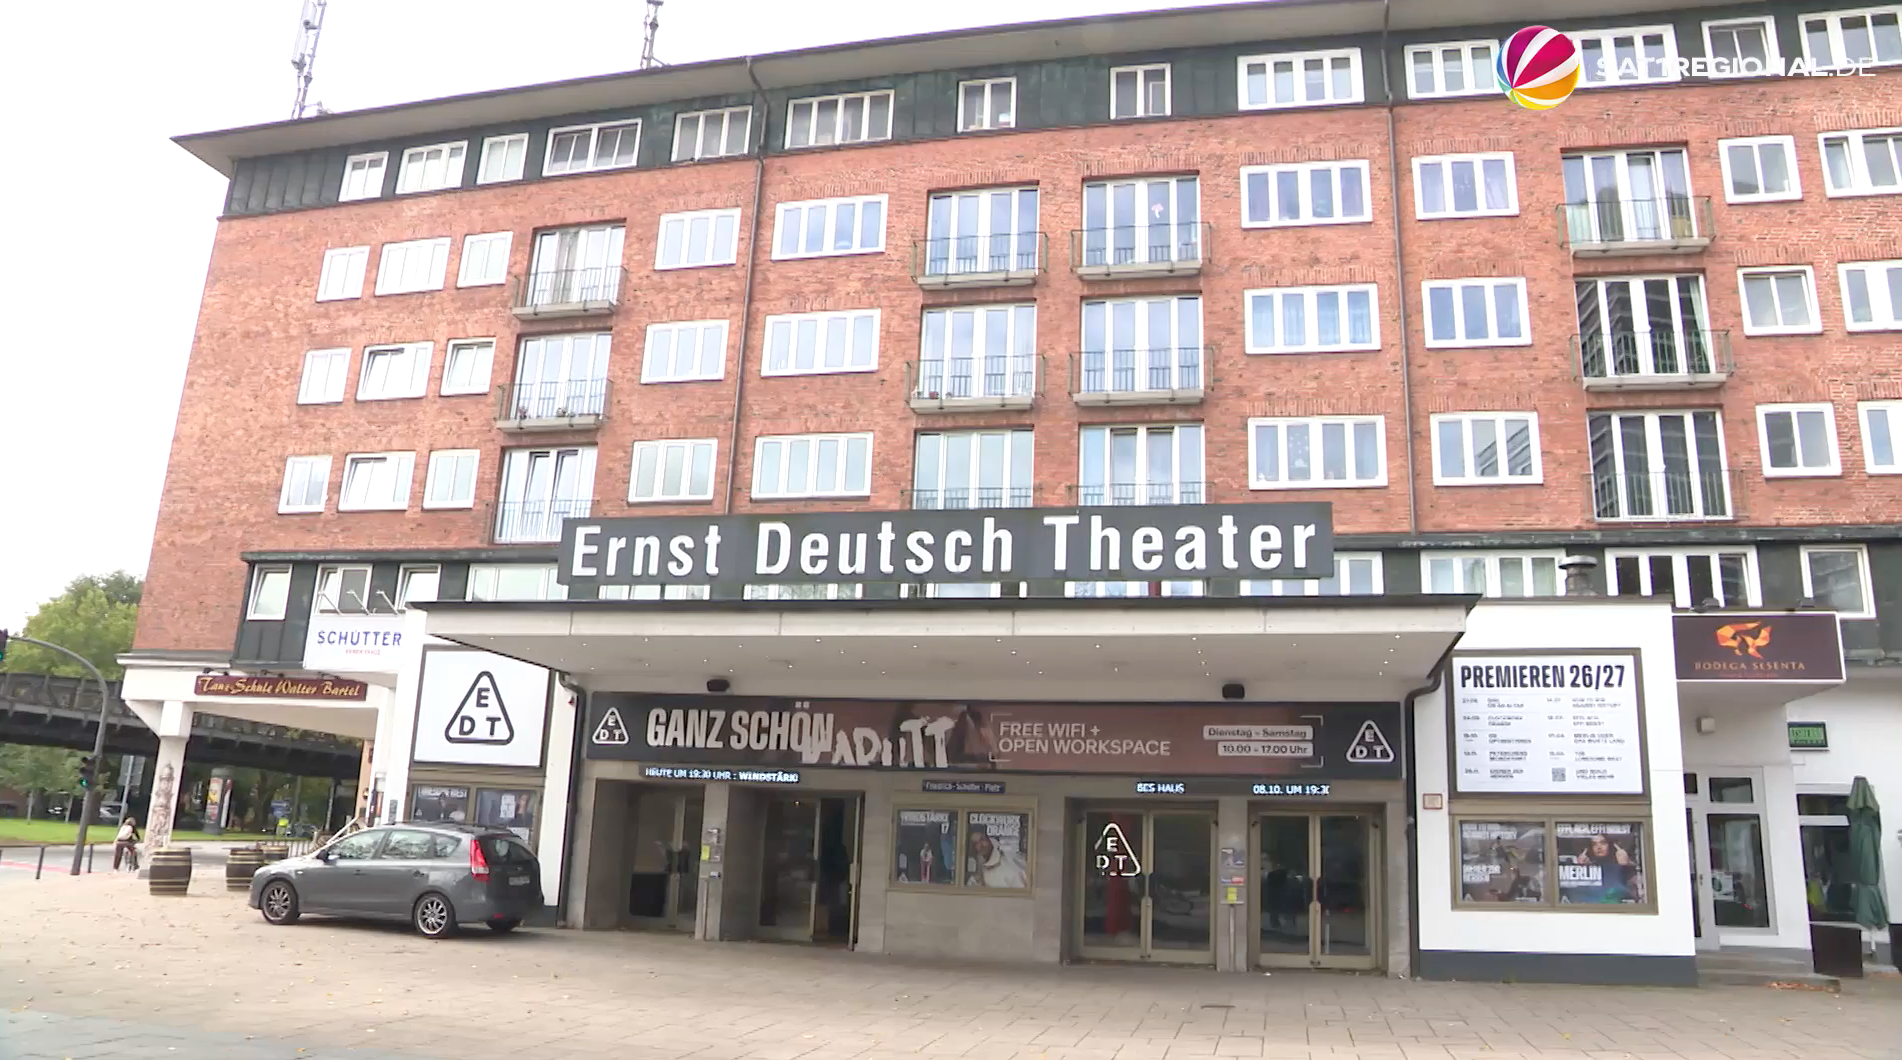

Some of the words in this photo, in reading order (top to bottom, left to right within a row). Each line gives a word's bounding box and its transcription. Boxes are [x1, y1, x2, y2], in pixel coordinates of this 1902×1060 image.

[571, 525, 722, 576] Ernst
[755, 516, 1012, 575] Deutsch
[1043, 514, 1316, 571] Theater
[317, 629, 402, 647] SCHÜTTER
[1694, 661, 1747, 670] BODEGA
[1752, 661, 1806, 670] SESENTA
[1460, 665, 1566, 688] PREMIEREN
[1569, 664, 1626, 690] 26/27
[275, 679, 318, 694] Walter
[647, 707, 726, 749] GANZ
[730, 701, 834, 753] SCHÖN
[999, 722, 1044, 737] FREE
[1048, 723, 1086, 738] WIFI
[1208, 727, 1252, 739] Dienstag
[1262, 728, 1307, 739] Samstag
[998, 737, 1049, 753] OPEN
[1053, 739, 1172, 756] WORKSPACE
[1222, 745, 1251, 753] 10.00
[1261, 745, 1288, 754] 17.00
[1289, 745, 1309, 754] Uhr
[645, 767, 672, 778] HEUTE
[673, 769, 687, 778] UM
[712, 770, 732, 780] UHR
[1158, 783, 1185, 794] HAUS
[1286, 785, 1302, 795] UM
[1559, 865, 1602, 881] MERLIN
